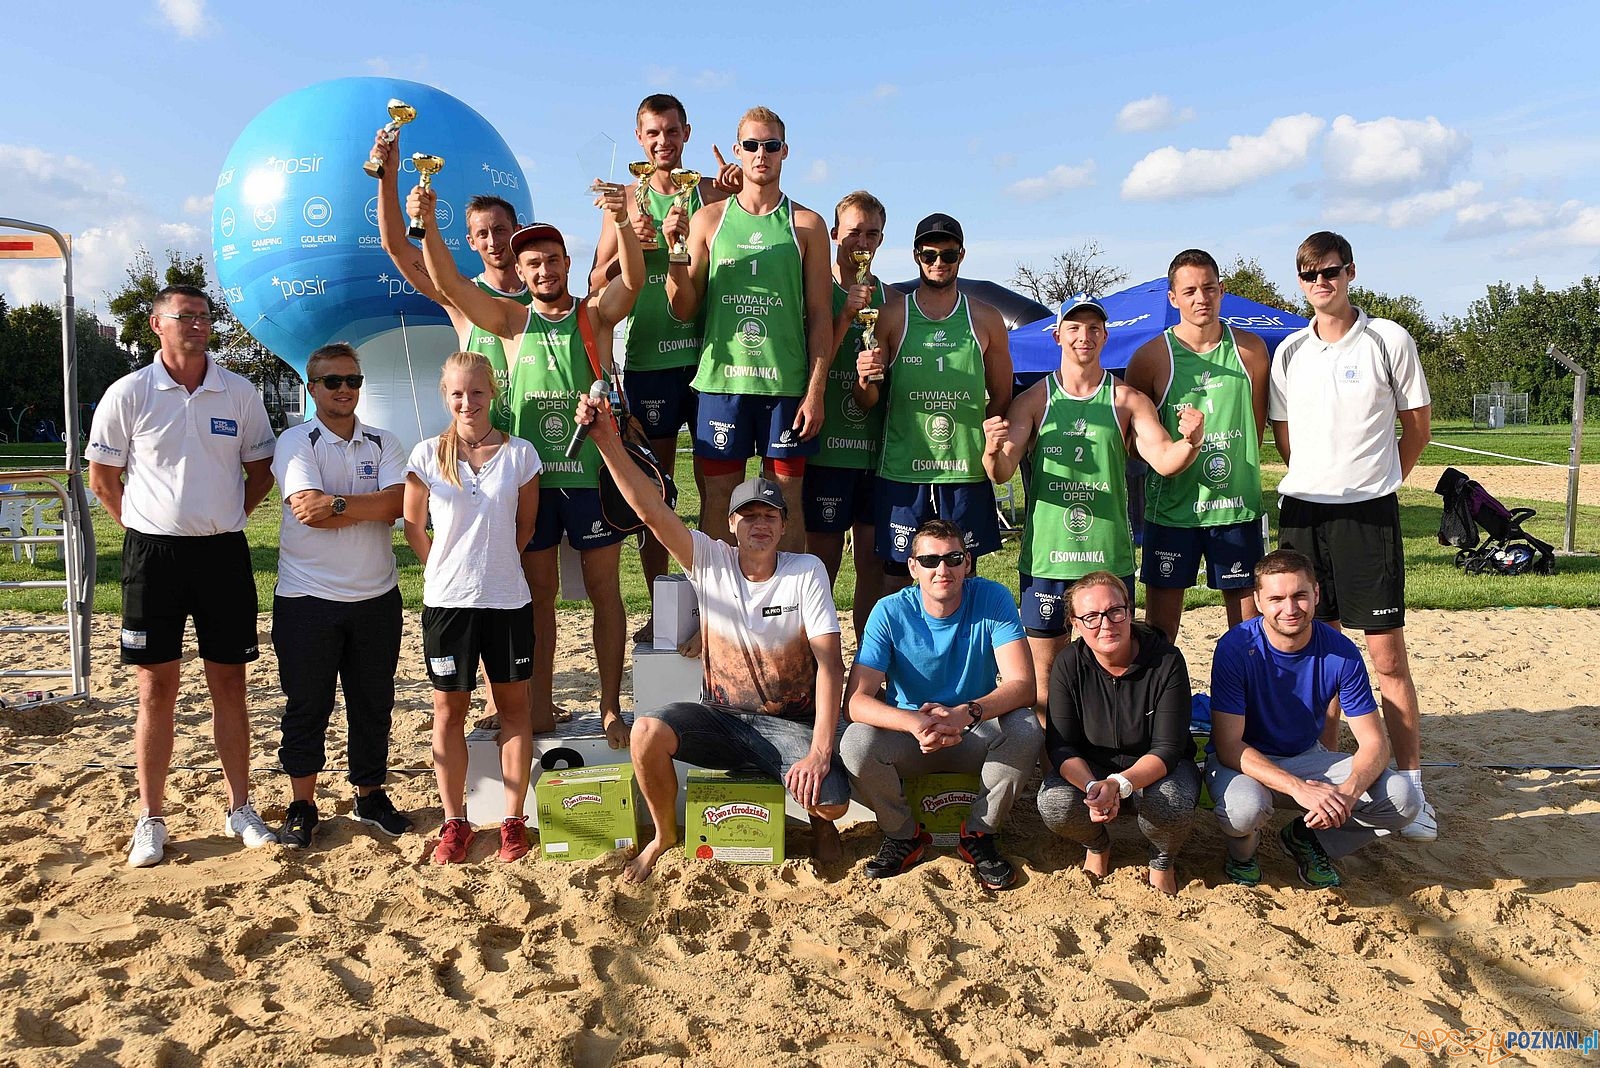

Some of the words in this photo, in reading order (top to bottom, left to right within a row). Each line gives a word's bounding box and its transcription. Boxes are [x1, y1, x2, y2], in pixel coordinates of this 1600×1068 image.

[251, 237, 283, 248] CAMPING
[301, 235, 337, 244] GOLĘCIN
[749, 259, 758, 275] 1
[280, 275, 327, 301] posir
[721, 294, 784, 307] CHWIAŁKA
[735, 304, 769, 316] OPEN
[658, 337, 704, 353] CISOWIANK
[902, 356, 922, 364] TODO
[936, 356, 943, 372] 1
[724, 364, 778, 380] CISOWIANKA
[524, 390, 583, 401] CHWIAŁKA
[909, 391, 971, 401] CHWIAŁKA
[537, 400, 570, 410] OPEN
[924, 401, 957, 410] OPEN
[1205, 399, 1214, 414] 1
[1200, 440, 1231, 453] OPEN
[1074, 447, 1083, 462] 2
[912, 458, 968, 472] CISOWIANKA
[1048, 481, 1110, 491] CHWIAŁKA
[1063, 491, 1095, 501] OPEN
[1193, 495, 1245, 514] CISOWIANKA
[1049, 550, 1105, 563] CISOWIANKA
[923, 798, 945, 811] Piwo
[706, 810, 727, 822] Piwo
[731, 805, 768, 820] Grodziska
